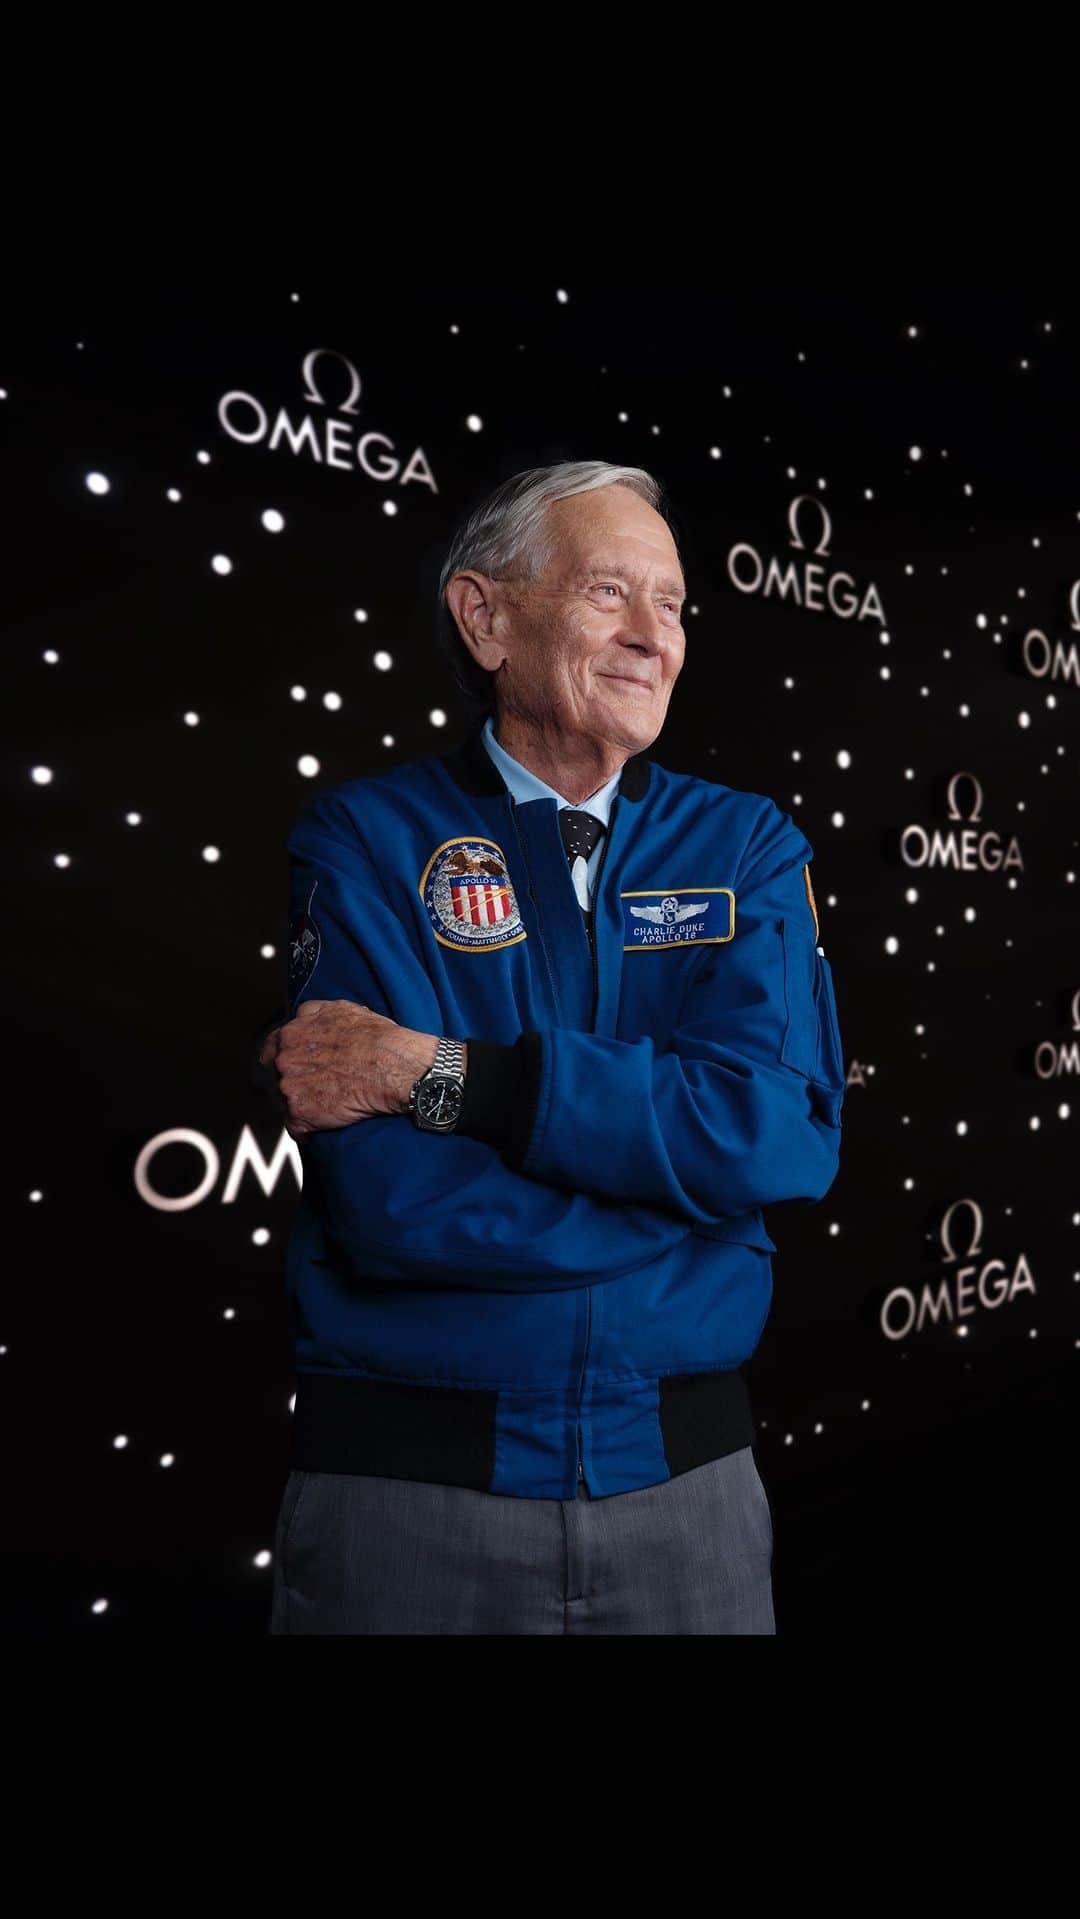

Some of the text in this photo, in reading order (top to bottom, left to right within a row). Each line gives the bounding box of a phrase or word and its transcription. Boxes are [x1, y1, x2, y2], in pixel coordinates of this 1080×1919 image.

[218, 389, 439, 494] OMEGA
[728, 541, 887, 627] OMEGA
[901, 823, 1025, 872] OMEGA
[633, 923, 705, 936] CHARLIE DUKE
[641, 932, 696, 944] APOLLO 16
[880, 1252, 1037, 1341] OMEGA
